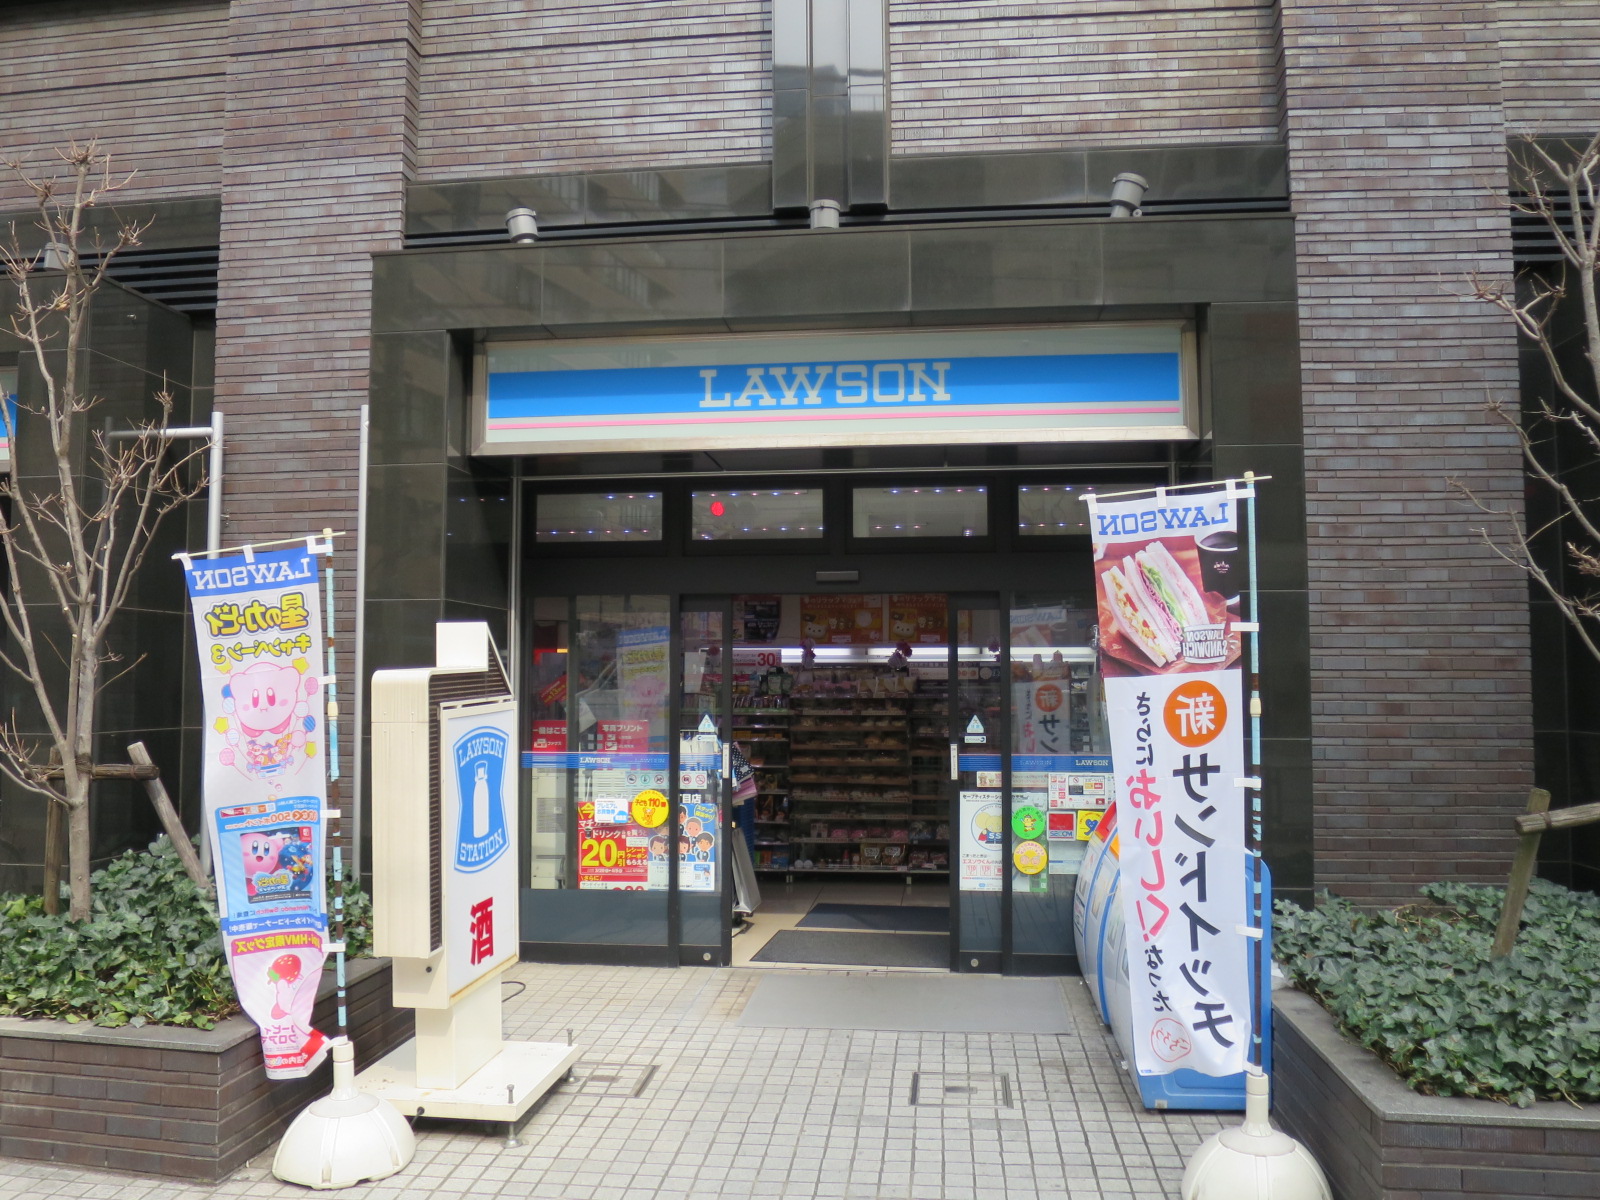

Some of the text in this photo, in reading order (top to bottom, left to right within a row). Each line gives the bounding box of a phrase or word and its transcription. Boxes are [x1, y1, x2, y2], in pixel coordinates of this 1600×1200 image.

[699, 361, 952, 409] LAWSON
[458, 736, 503, 767] LAWSON
[459, 831, 503, 862] STATION
[581, 838, 618, 868] 20
[470, 897, 495, 967] 酒
